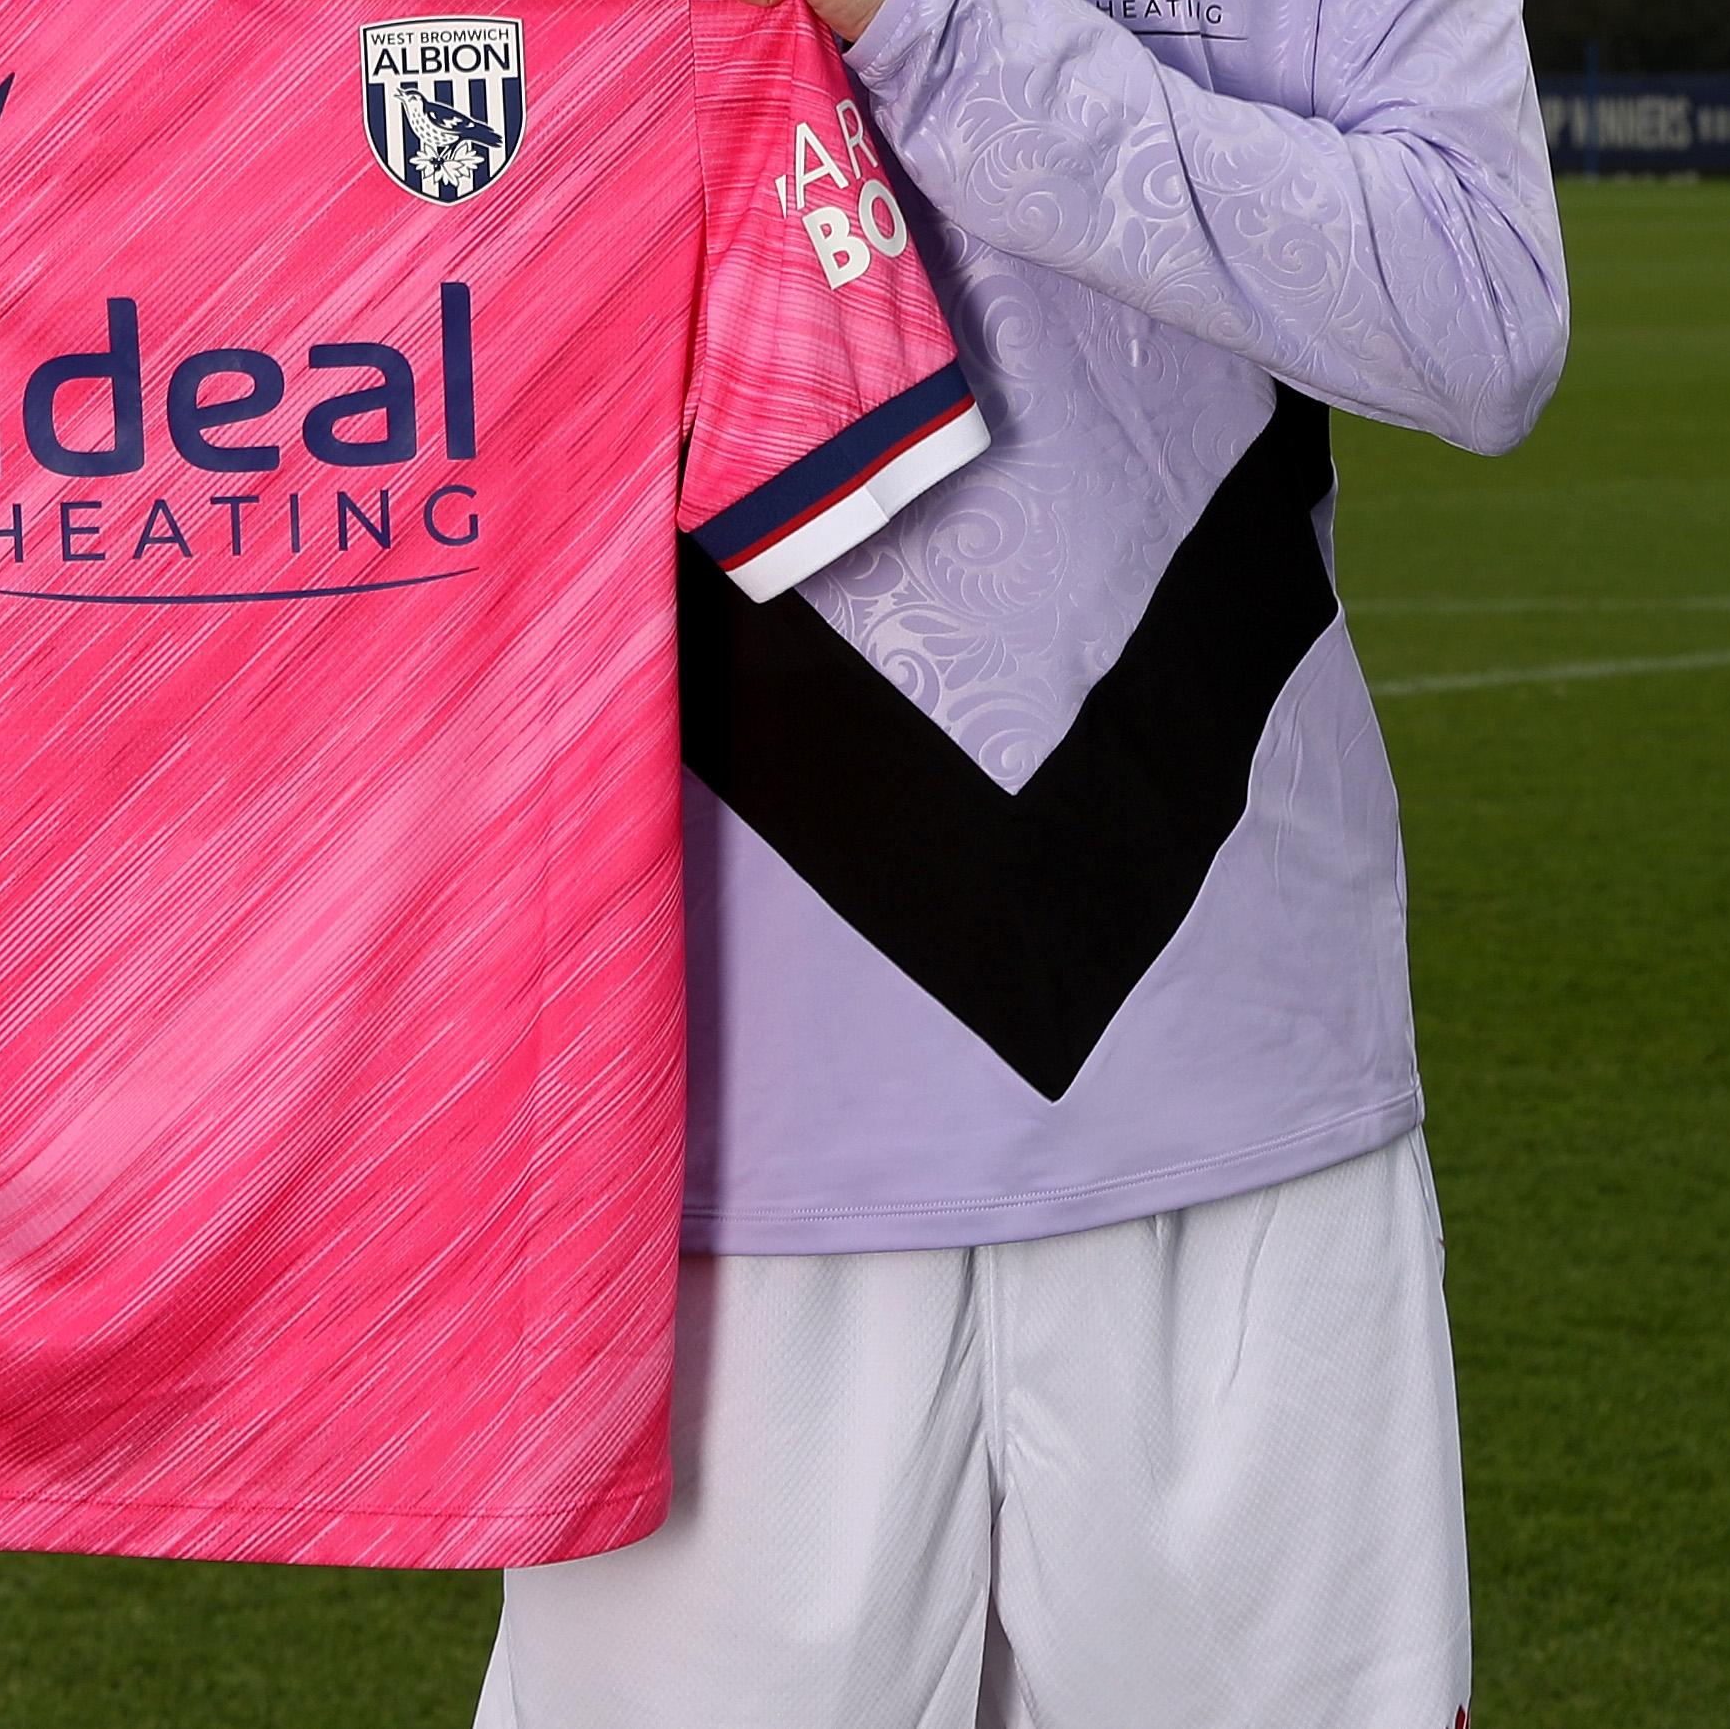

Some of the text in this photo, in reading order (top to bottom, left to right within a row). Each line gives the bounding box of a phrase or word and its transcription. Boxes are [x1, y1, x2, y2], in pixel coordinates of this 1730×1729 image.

[371, 28, 509, 46] WEST BROMWICH
[372, 43, 510, 77] ALBION
